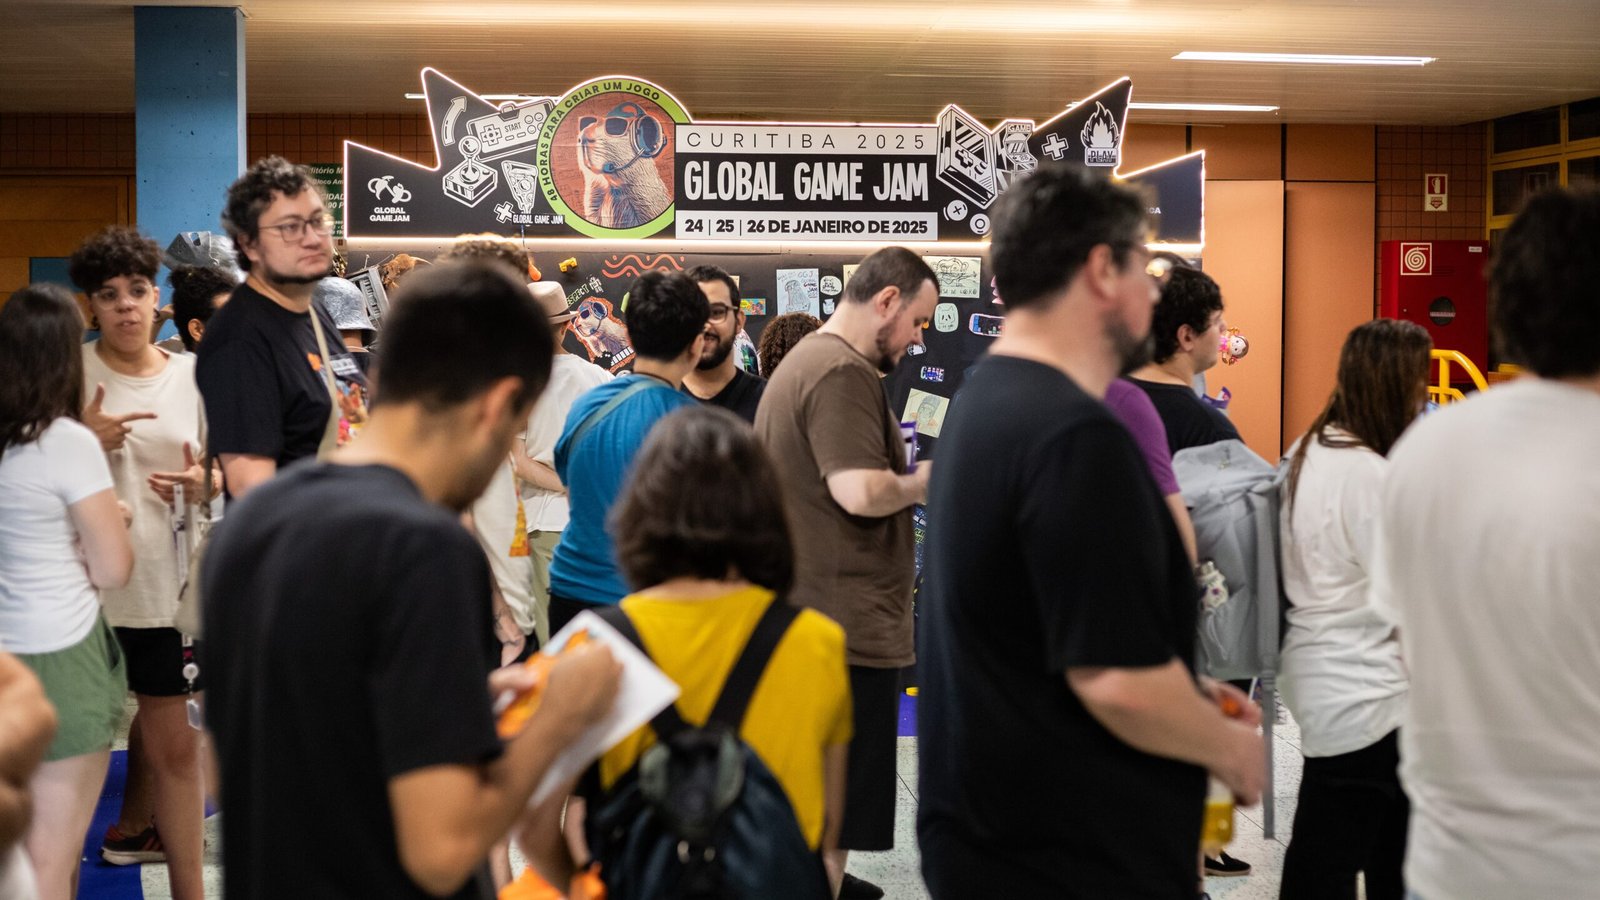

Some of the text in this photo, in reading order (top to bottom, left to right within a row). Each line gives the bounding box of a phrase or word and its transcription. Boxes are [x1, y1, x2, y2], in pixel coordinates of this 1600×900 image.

[504, 122, 522, 133] START
[539, 82, 660, 201] 48 HORAS PARA CRIAR UM JOGO
[687, 132, 924, 149] CURITIBA 2025
[1090, 150, 1114, 160] PLAY
[684, 160, 928, 201] GLOBAL GAME JAM
[513, 214, 564, 224] GLOBAL GAME JAM
[685, 219, 928, 234] 24 25 26 DE JANEIRO DE 2025
